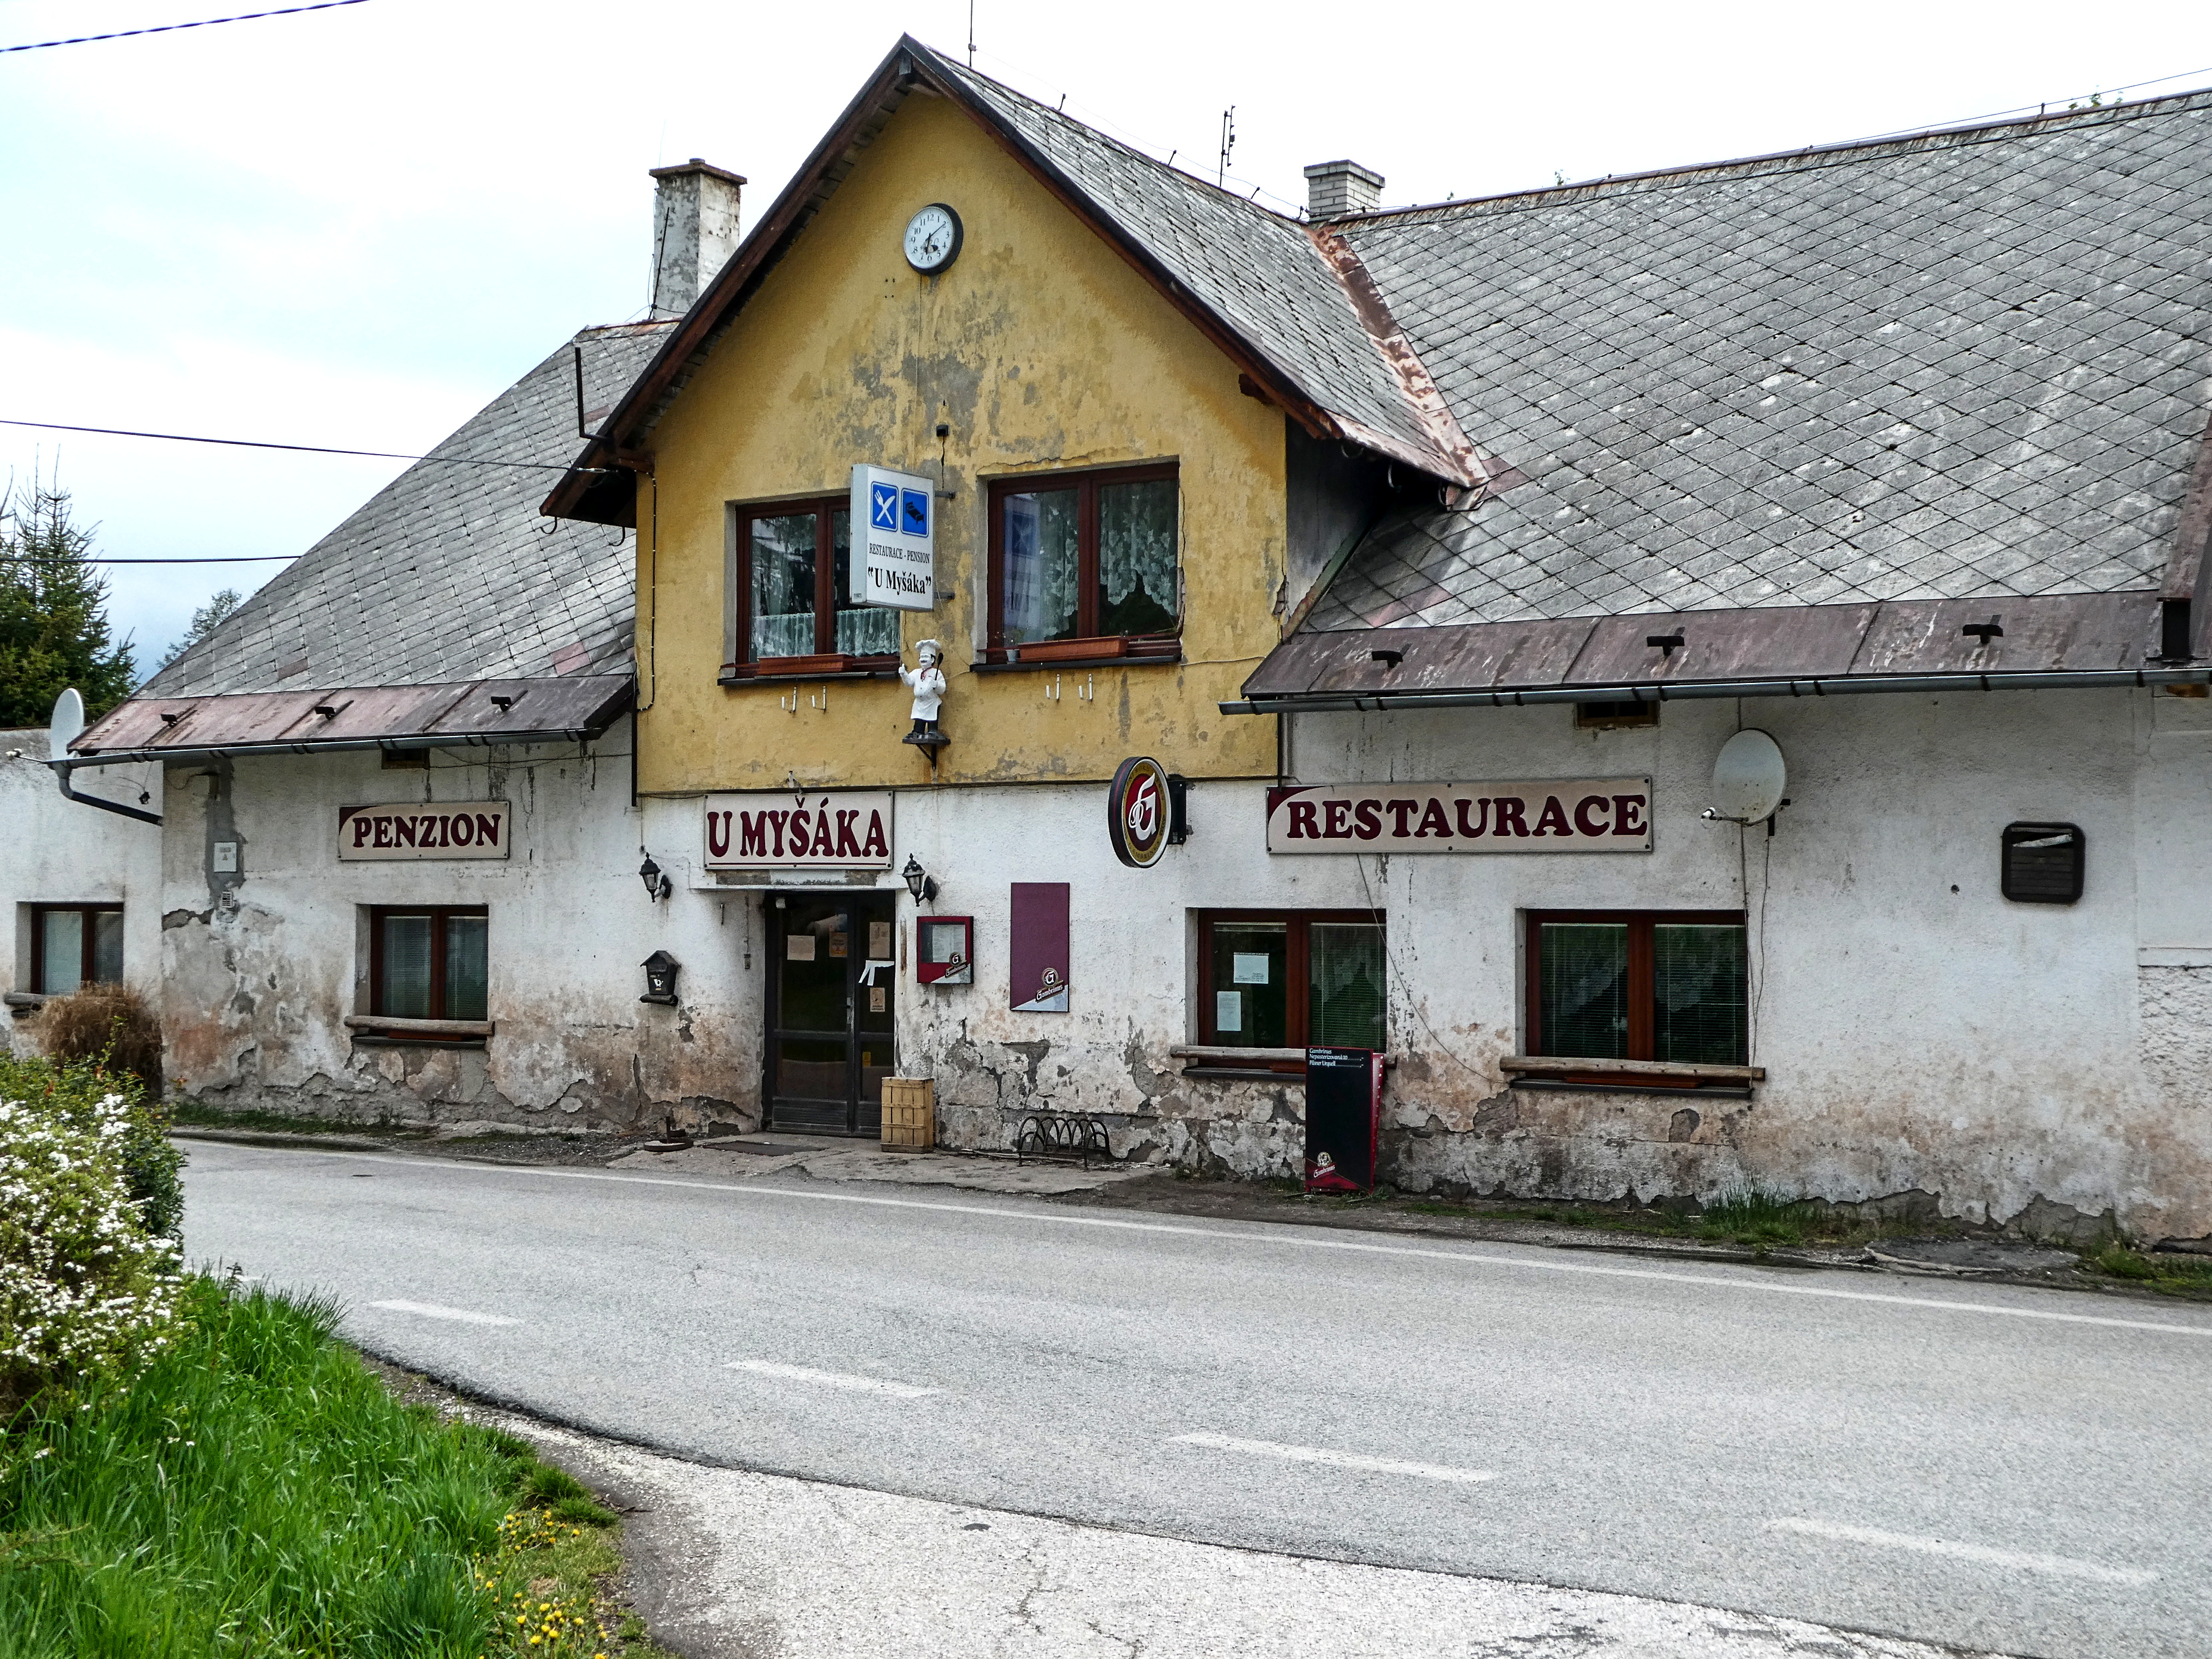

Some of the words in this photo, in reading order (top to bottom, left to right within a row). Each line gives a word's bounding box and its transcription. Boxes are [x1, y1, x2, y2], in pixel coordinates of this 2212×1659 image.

[869, 543, 903, 560] RESTAURACE
[907, 550, 930, 564] PENSION
[352, 813, 501, 848] PENZION
[707, 810, 732, 858] U
[740, 796, 889, 858] MYŠÁKA
[1287, 794, 1648, 840] RESTAURACE
[1036, 984, 1063, 1001] Gambrinus
